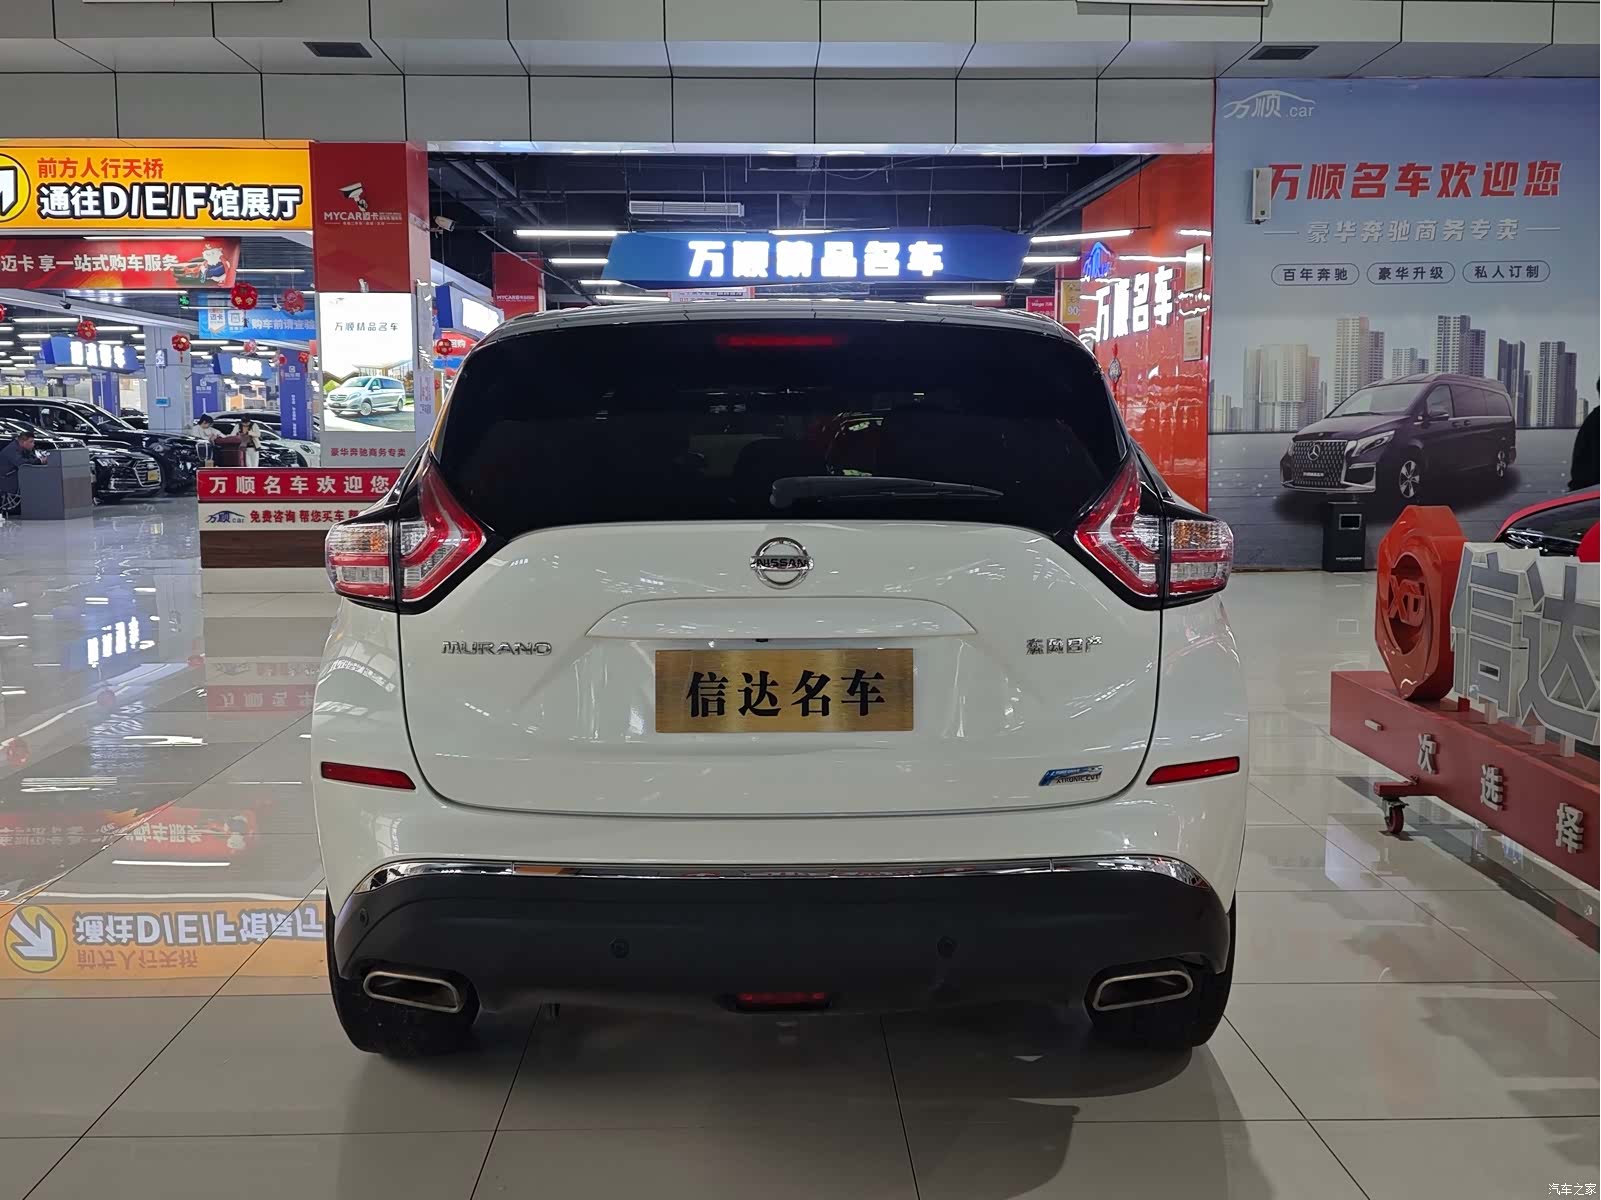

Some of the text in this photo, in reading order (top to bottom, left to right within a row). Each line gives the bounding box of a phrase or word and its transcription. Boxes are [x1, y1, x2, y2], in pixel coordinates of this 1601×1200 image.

[37, 157, 164, 179] 前方人行天桥
[1269, 160, 1563, 200] 万顺名车欢迎您
[38, 184, 301, 218] 通往D/E/F馆展厅
[1307, 217, 1520, 243] 豪华奔驰商务专卖
[1, 254, 178, 273] 迈卡 享一站式购车服务
[688, 240, 944, 278] 万顺精品名车
[1282, 266, 1348, 281] 百年奔驰
[1377, 265, 1444, 280] 豪华升级
[1474, 264, 1540, 279] 私人订制
[334, 321, 399, 332] 万顺精品名车
[330, 447, 407, 457] 豪华奔驰商务专卖
[209, 475, 390, 494] 万顺名车欢迎您
[250, 509, 296, 523] 免费咨询
[300, 510, 345, 523] 帮您买车
[756, 557, 809, 569] NISSAN
[441, 640, 553, 656] MURANO
[686, 668, 886, 718] 信达名车
